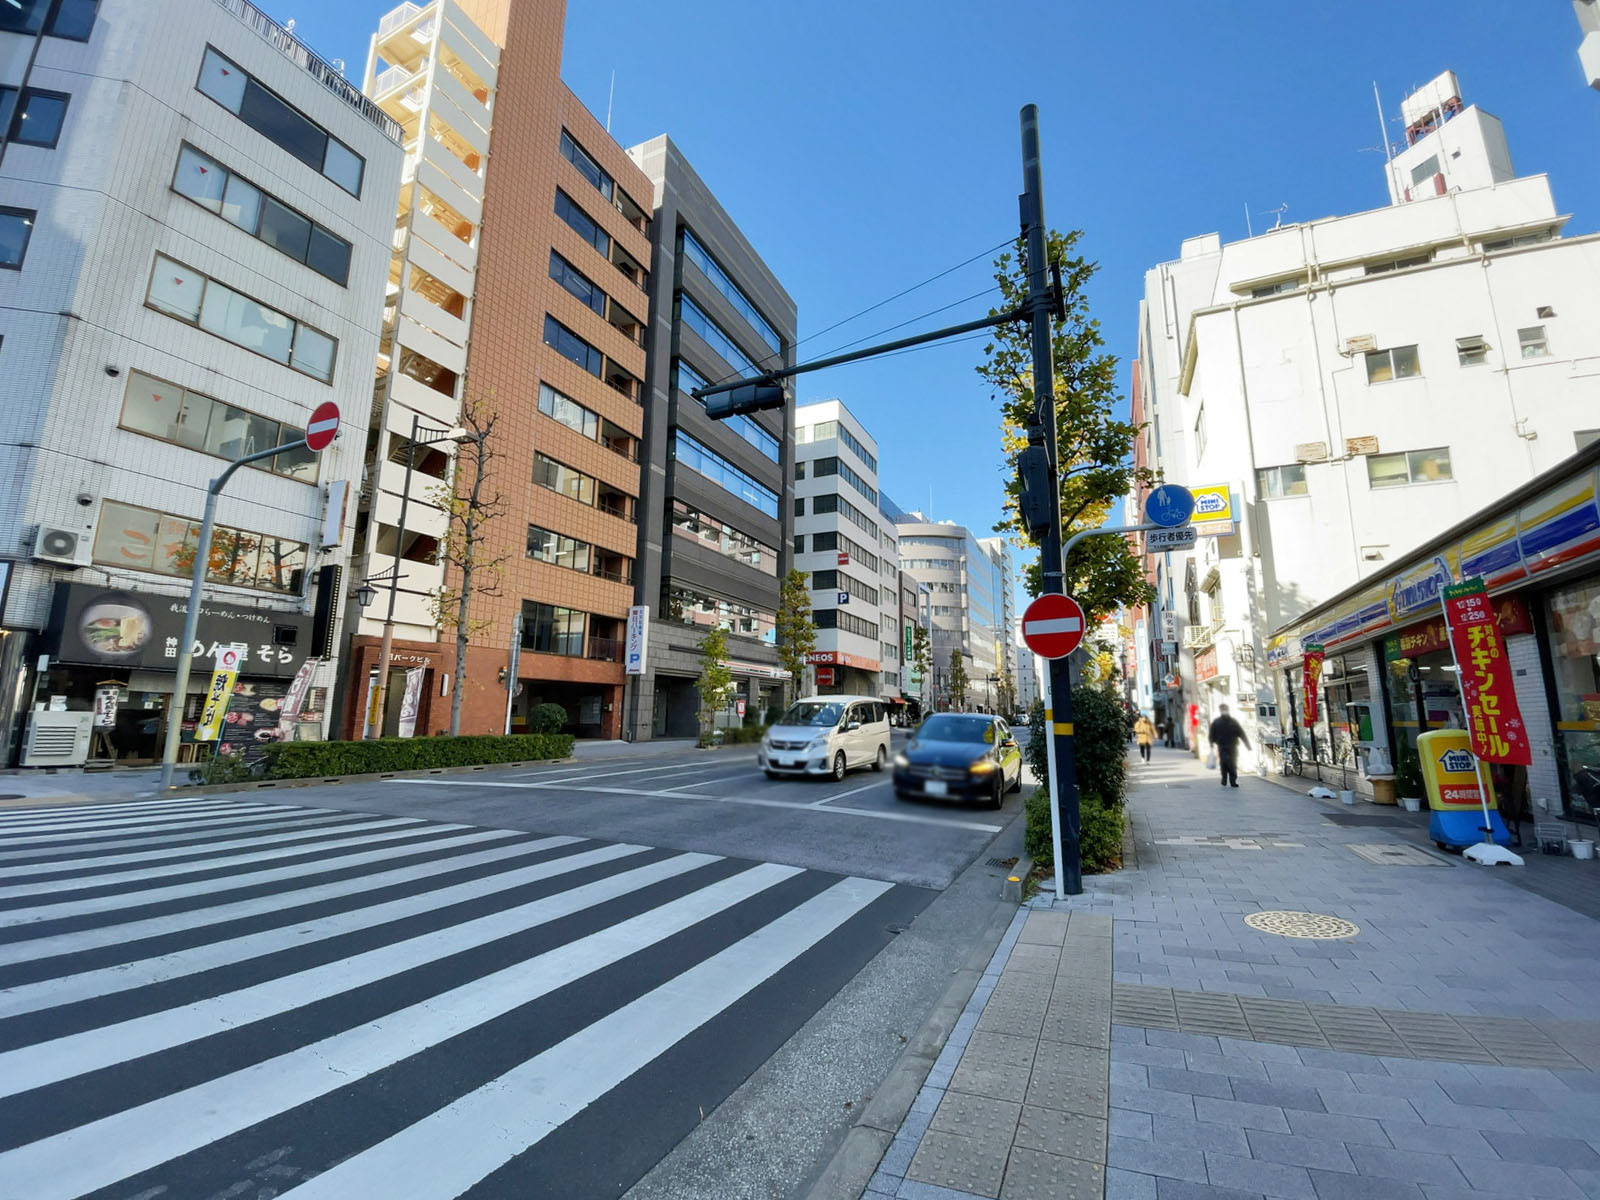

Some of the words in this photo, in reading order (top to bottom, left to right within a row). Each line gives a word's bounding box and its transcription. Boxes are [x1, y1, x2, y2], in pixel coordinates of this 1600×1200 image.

[1150, 531, 1193, 543] 歩行者優先
[840, 593, 847, 603] P
[165, 637, 178, 657] 神田
[257, 645, 293, 663] そら
[630, 654, 640, 663] P
[1467, 625, 1509, 757] チキンセール
